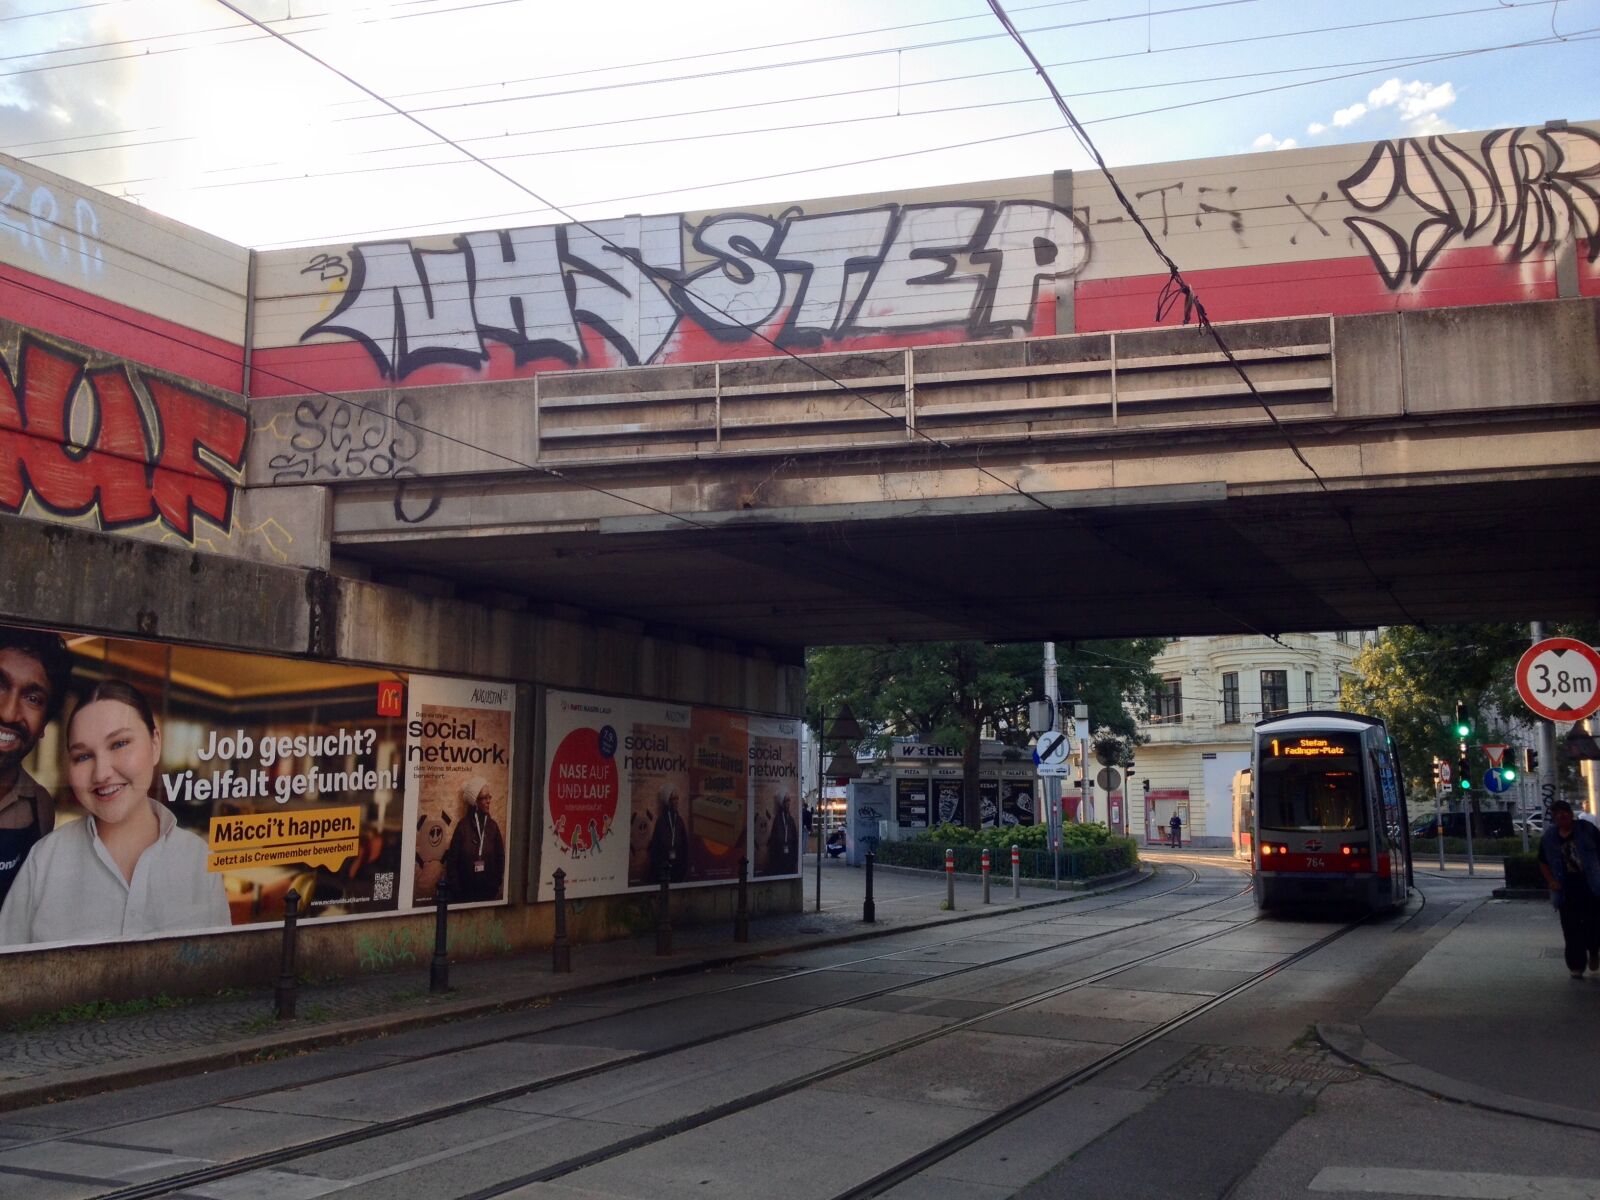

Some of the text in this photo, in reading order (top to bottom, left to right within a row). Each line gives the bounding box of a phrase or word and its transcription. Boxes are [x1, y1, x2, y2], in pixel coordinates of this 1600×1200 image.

[1534, 663, 1592, 698] 3,8m
[408, 718, 476, 740] social
[198, 728, 377, 767] Job gesucht?
[624, 734, 669, 752] social
[1271, 740, 1279, 756] 1
[1284, 747, 1344, 755] Fadinger-Platz
[1300, 739, 1328, 747] Stefan
[749, 744, 782, 761] social
[559, 764, 609, 780] NASE AUF
[162, 764, 399, 804] Vielfalt gefunden!
[557, 783, 611, 799] UND LAUF
[288, 816, 356, 840] happen.
[213, 842, 354, 867] Jetzt als Crewmember bewerben!
[1306, 857, 1325, 867] 764
